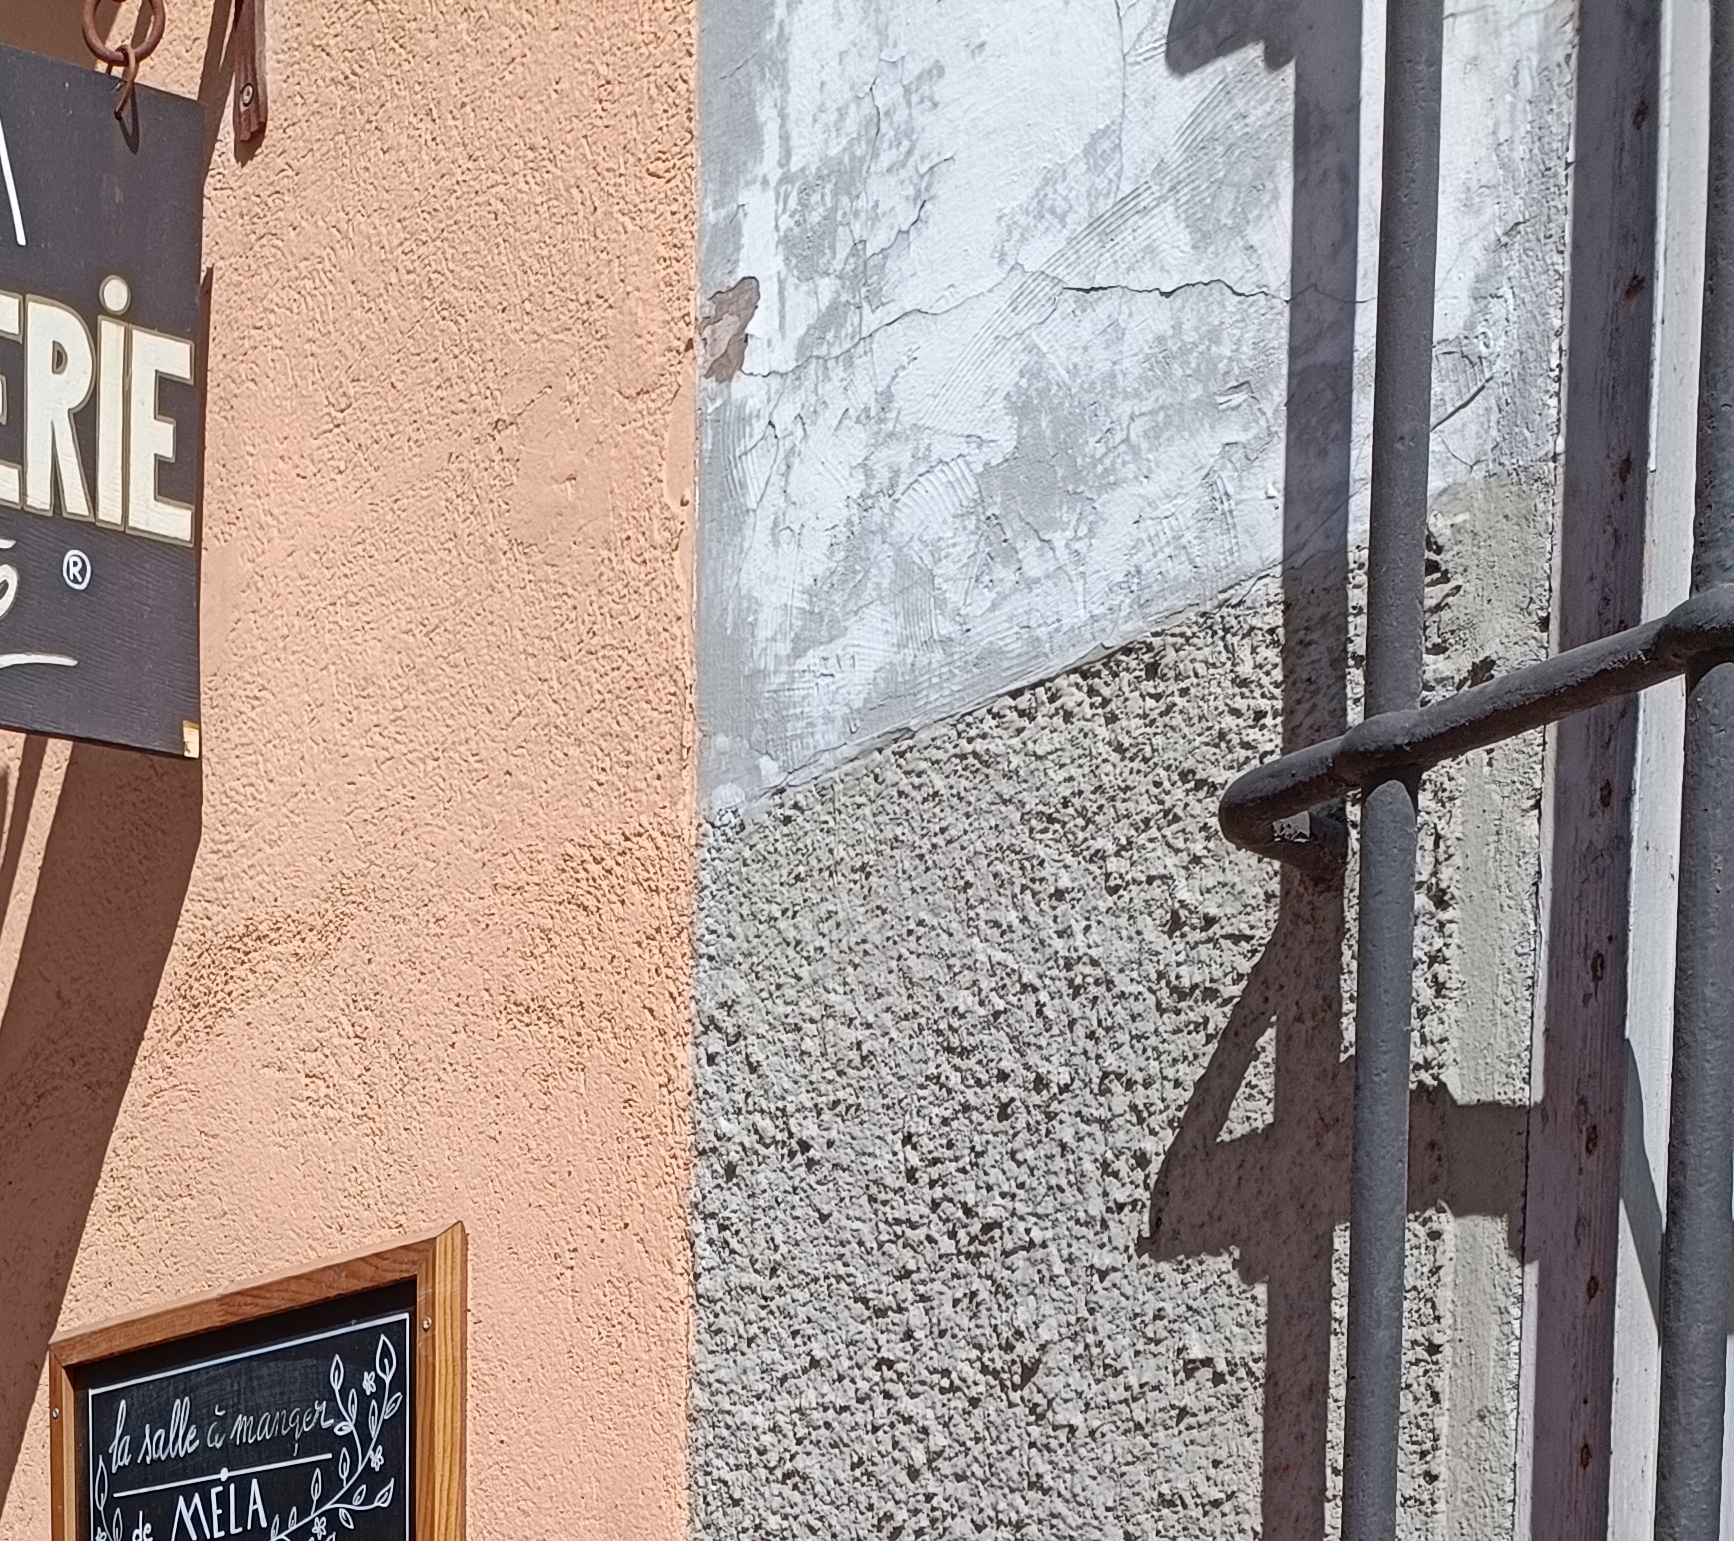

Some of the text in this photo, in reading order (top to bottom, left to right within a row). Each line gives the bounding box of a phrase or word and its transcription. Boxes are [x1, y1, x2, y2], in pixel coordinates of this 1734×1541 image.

[109, 1397, 334, 1474] la salle à manger
